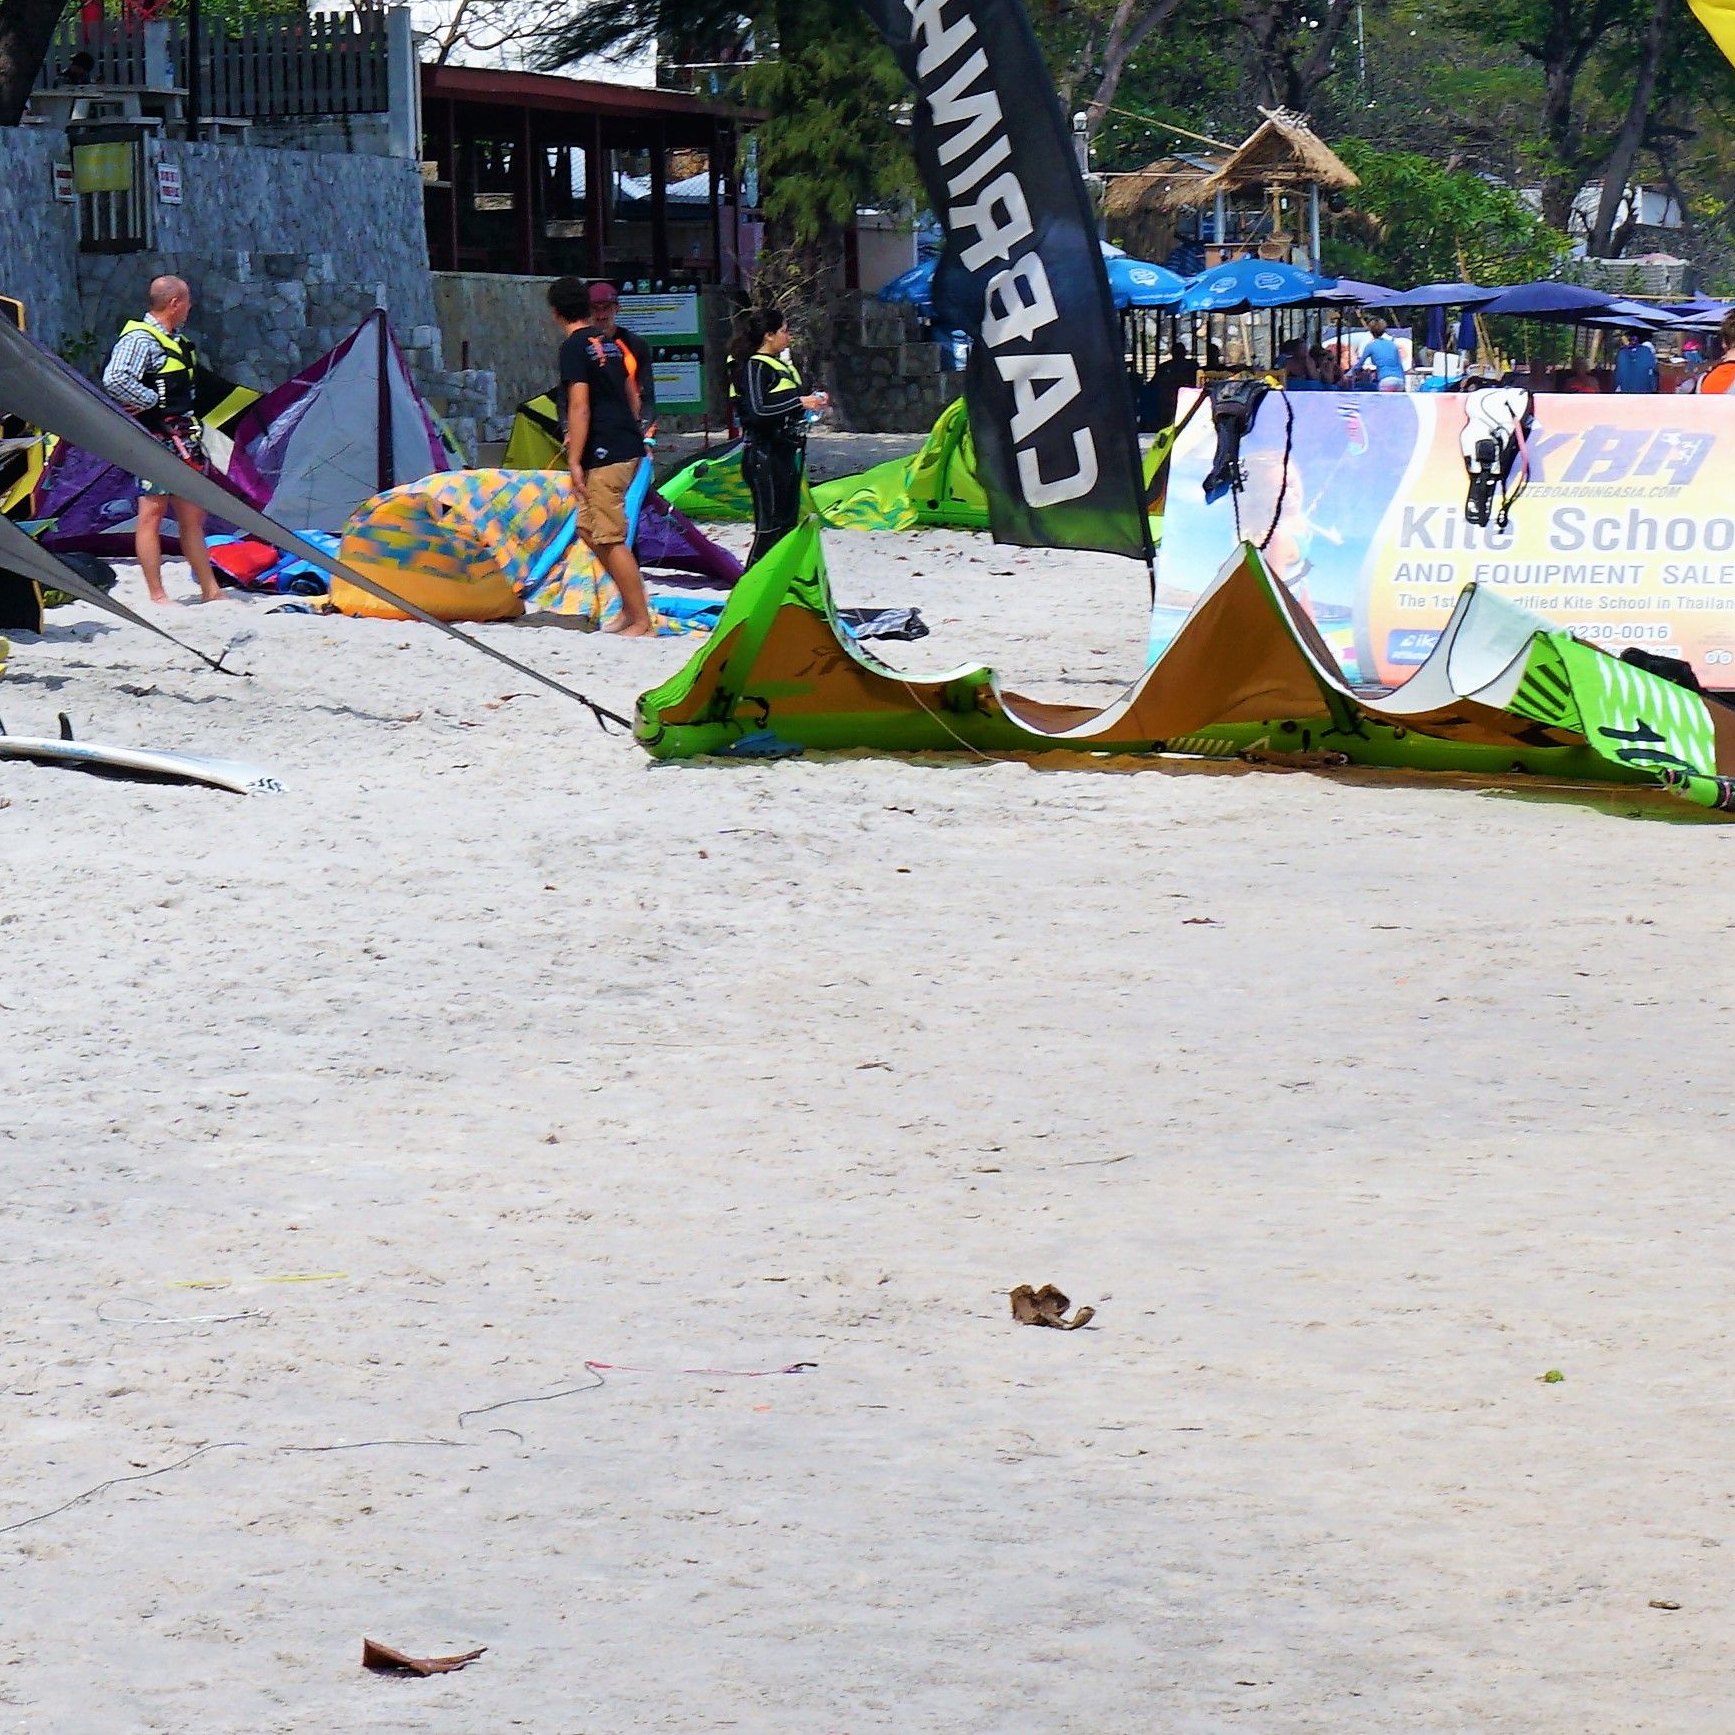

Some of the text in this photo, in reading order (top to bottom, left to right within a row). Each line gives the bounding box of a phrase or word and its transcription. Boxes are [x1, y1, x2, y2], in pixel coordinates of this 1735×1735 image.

[1399, 506, 1516, 550] Kite
[1394, 562, 1454, 583] AND
[1474, 563, 1645, 585] EQUIPMENT
[1399, 593, 1426, 607] The
[1564, 596, 1593, 610] Kite
[1598, 596, 1652, 610] School
[1657, 596, 1672, 610] in
